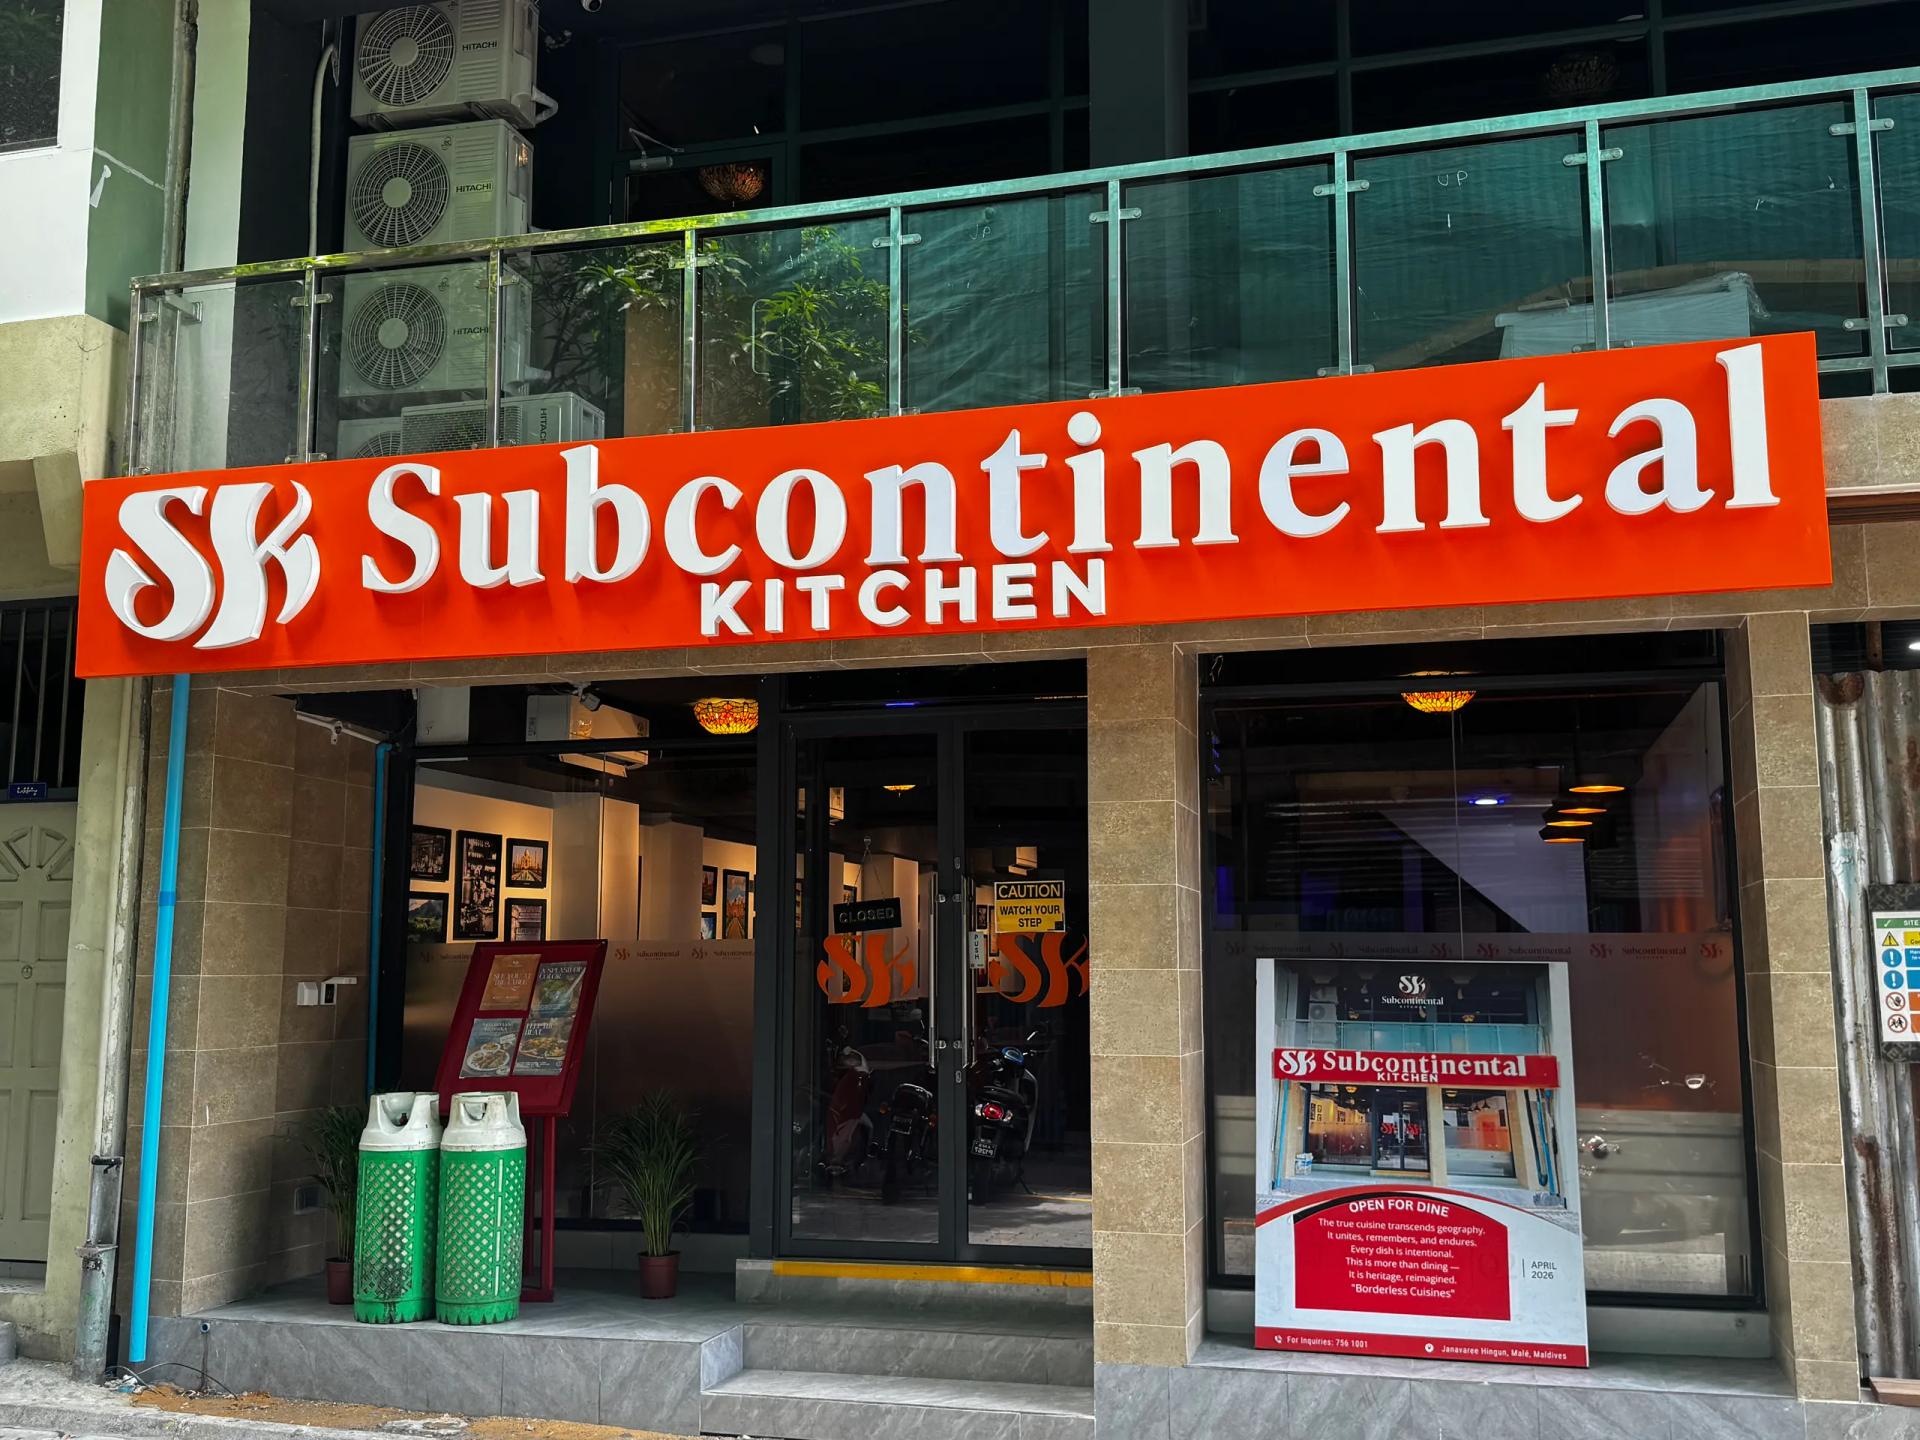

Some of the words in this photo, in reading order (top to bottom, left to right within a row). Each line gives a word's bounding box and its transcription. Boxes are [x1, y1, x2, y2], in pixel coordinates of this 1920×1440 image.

[462, 41, 498, 51] HITACHI
[456, 182, 492, 192] HITACHI
[453, 326, 489, 335] HITACHI
[362, 342, 1780, 594] Subcontinental
[700, 557, 1108, 637] KITCHEN
[998, 884, 1061, 898] CAUTION
[839, 907, 895, 923] CLOSED
[1000, 905, 1032, 915] WATCH
[1034, 905, 1060, 914] YOUR
[1018, 918, 1042, 927] STEP
[1381, 996, 1444, 1005] Subcontinental
[1322, 1051, 1527, 1077] Subcontinental
[1377, 1072, 1439, 1083] KITCHEN
[1349, 1199, 1384, 1213] OPEN
[1388, 1199, 1413, 1211] FOR
[1417, 1201, 1449, 1217] DINE
[1318, 1218, 1335, 1227] The
[1336, 1220, 1354, 1228] true
[1356, 1220, 1386, 1230] cuisine
[1388, 1222, 1435, 1232] transcends
[1437, 1225, 1486, 1236] geography.
[1327, 1231, 1334, 1239] It
[1335, 1232, 1364, 1242] unites,
[1366, 1234, 1418, 1245] remembers,
[1420, 1236, 1437, 1245] and
[1439, 1237, 1477, 1247] endures.
[1350, 1245, 1374, 1256] Every
[1376, 1246, 1394, 1255] dish
[1396, 1247, 1403, 1255] is
[1405, 1248, 1454, 1258] intentional.
[1345, 1257, 1363, 1266] This
[1365, 1258, 1372, 1267] is
[1374, 1260, 1397, 1268] more
[1399, 1260, 1419, 1269] than
[1421, 1262, 1448, 1272] dining
[1531, 1261, 1557, 1270] APRIL
[1348, 1270, 1355, 1279] It
[1356, 1271, 1364, 1279] is
[1366, 1271, 1403, 1283] heritage,
[1405, 1274, 1457, 1285] reimagined.
[1531, 1271, 1554, 1279] 2026
[1351, 1284, 1408, 1296] "Borderless
[1410, 1286, 1455, 1298] Cuisines"
[1287, 1335, 1299, 1343] For
[1300, 1337, 1334, 1346] Inquiries:
[1336, 1339, 1349, 1347] 756
[1351, 1340, 1368, 1348] 1001
[1441, 1345, 1479, 1355] Janavaree
[1480, 1347, 1509, 1357] Hingun,
[1533, 1350, 1567, 1360] Maldives
